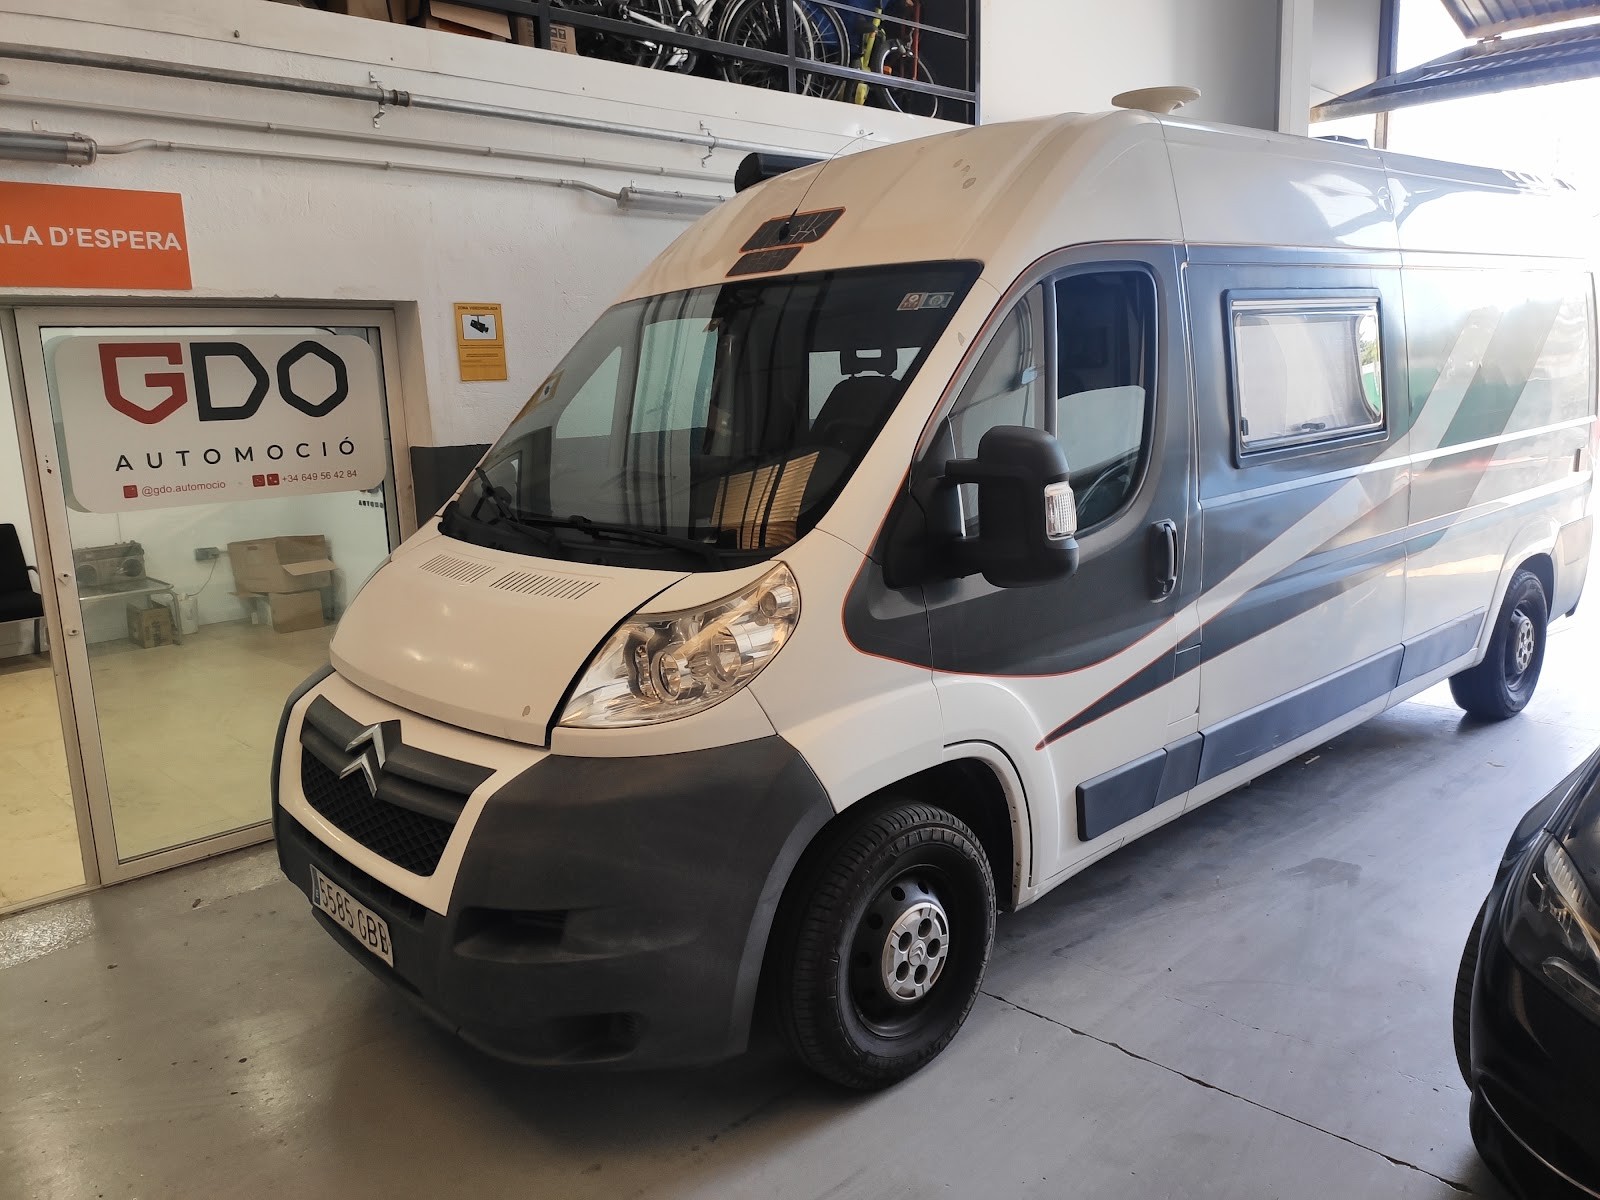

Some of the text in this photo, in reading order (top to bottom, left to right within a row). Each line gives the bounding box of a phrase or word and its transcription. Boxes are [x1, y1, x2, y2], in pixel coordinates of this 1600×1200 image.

[0, 225, 182, 251] LA D'ESPERA
[98, 340, 349, 425] GDO
[115, 437, 355, 472] AUTOMOCIÓ
[141, 480, 226, 498] @gdo.automocio
[282, 470, 357, 483] +34 649 56 42 84
[319, 877, 389, 955] 5585 GBB
